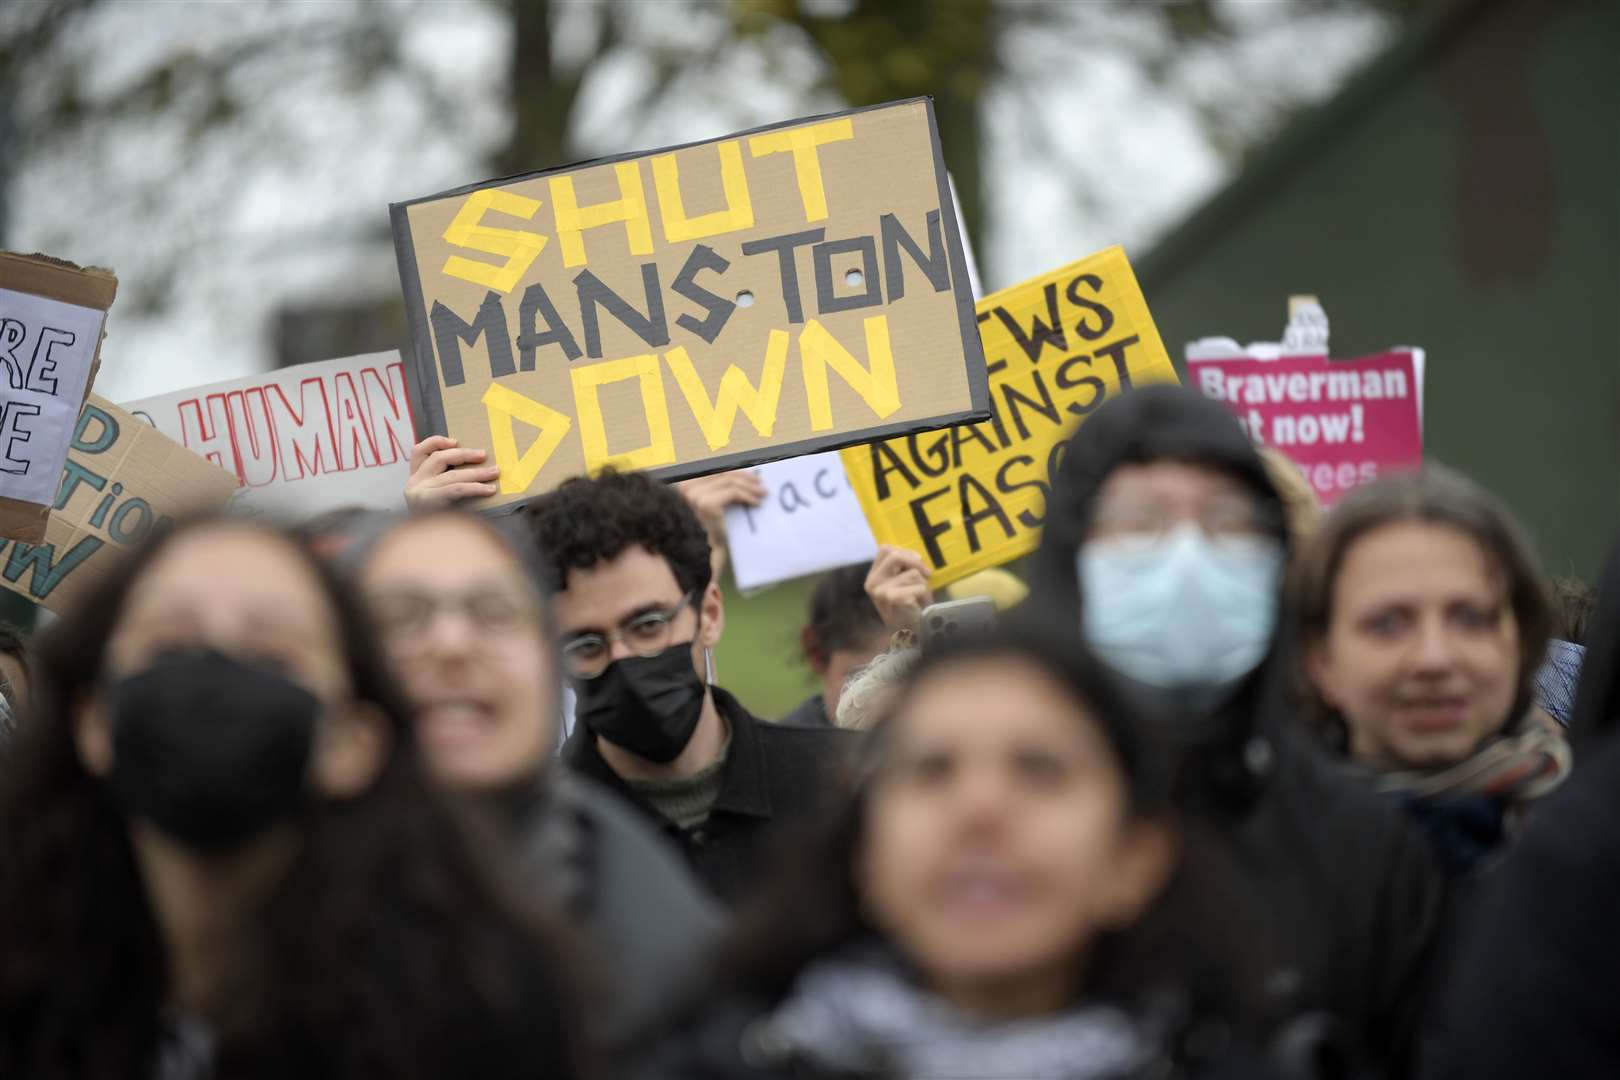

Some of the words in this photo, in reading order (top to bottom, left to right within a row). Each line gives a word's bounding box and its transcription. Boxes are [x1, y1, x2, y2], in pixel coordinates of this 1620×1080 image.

[442, 119, 853, 292] SHUT
[430, 208, 951, 387] MANSTON
[177, 362, 418, 488] HUMAN
[481, 315, 902, 494] DOWN
[869, 333, 1140, 502] AGAINST
[1198, 366, 1408, 403] Braverman
[1272, 403, 1365, 445] now!
[0, 533, 105, 600] W
